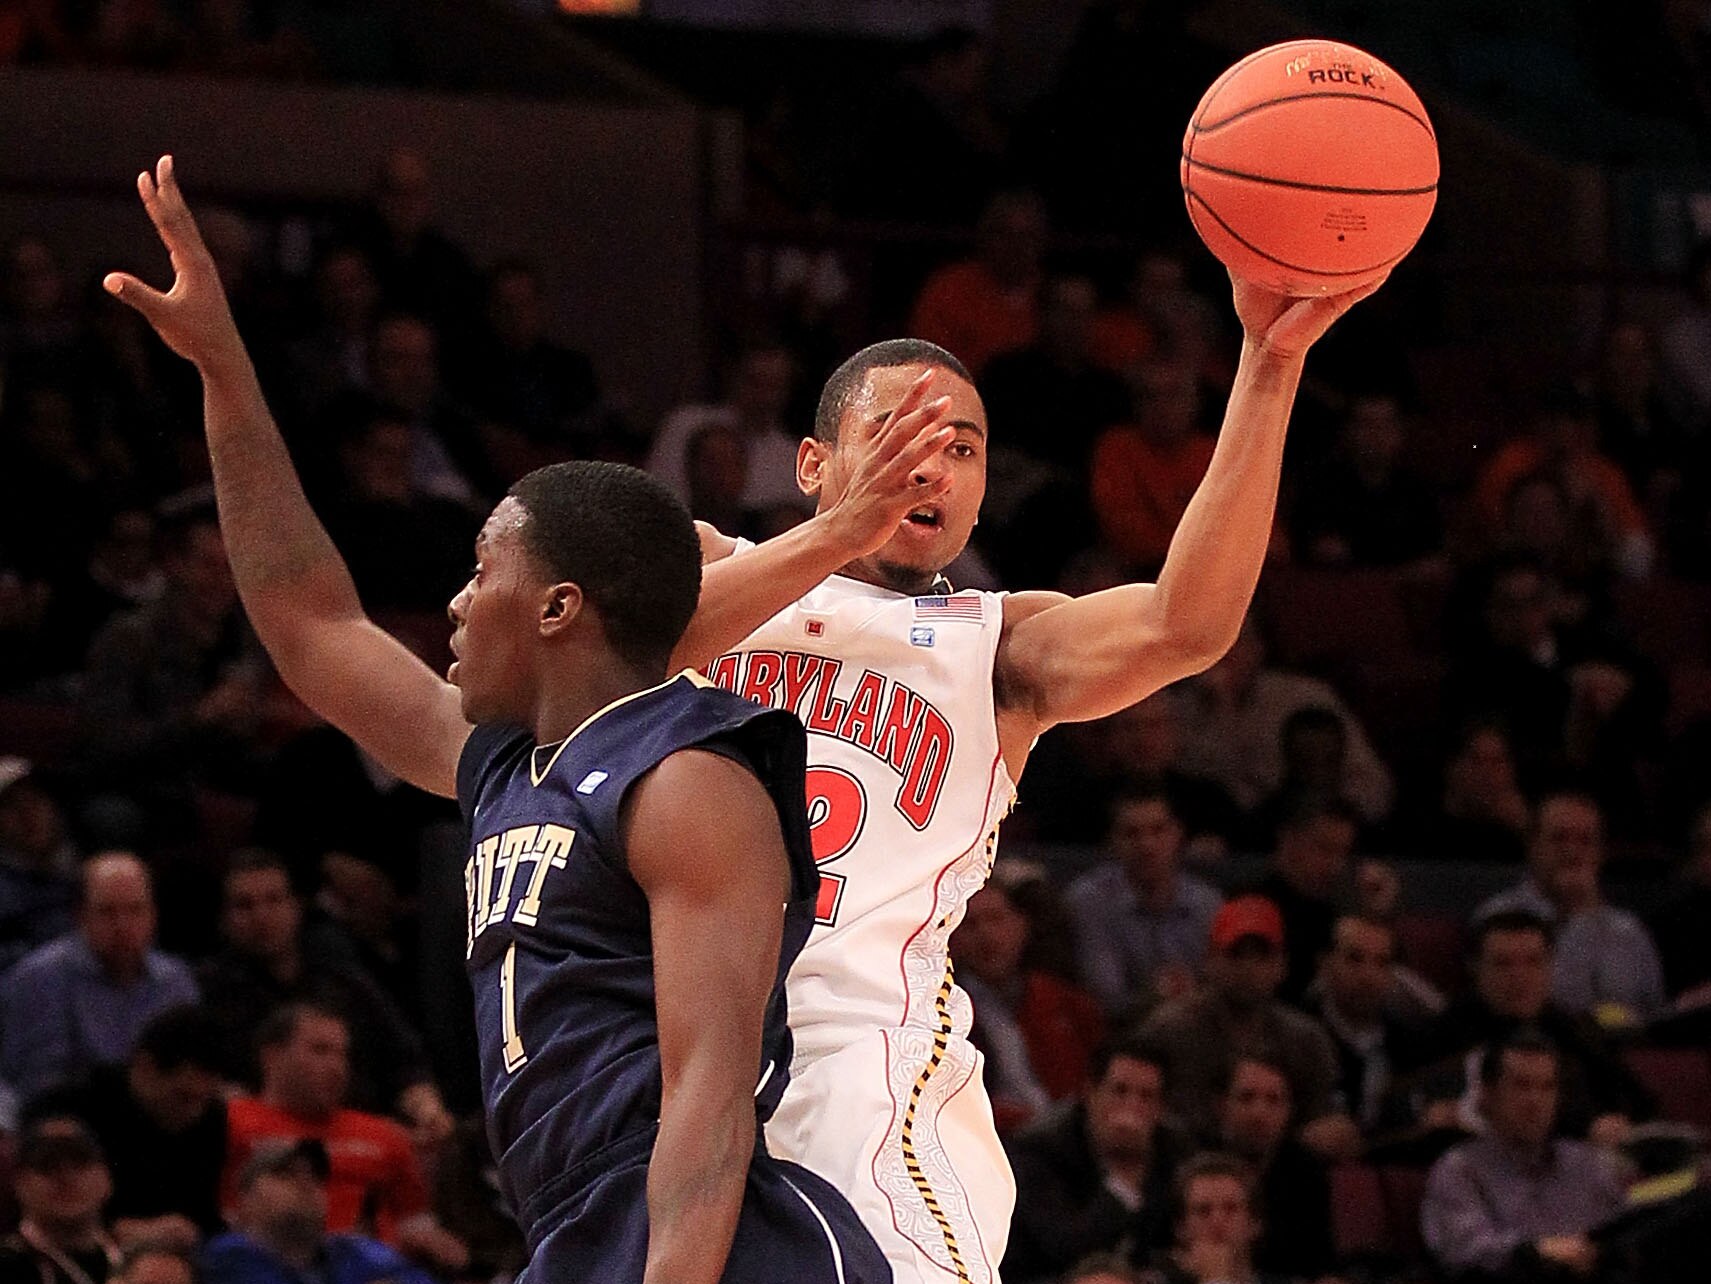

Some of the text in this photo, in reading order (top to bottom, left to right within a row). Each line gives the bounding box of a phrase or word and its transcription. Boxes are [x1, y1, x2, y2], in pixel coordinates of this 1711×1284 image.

[1309, 69, 1376, 90] ROCK
[698, 650, 954, 832] ARYLAND
[500, 938, 528, 1075] 1
